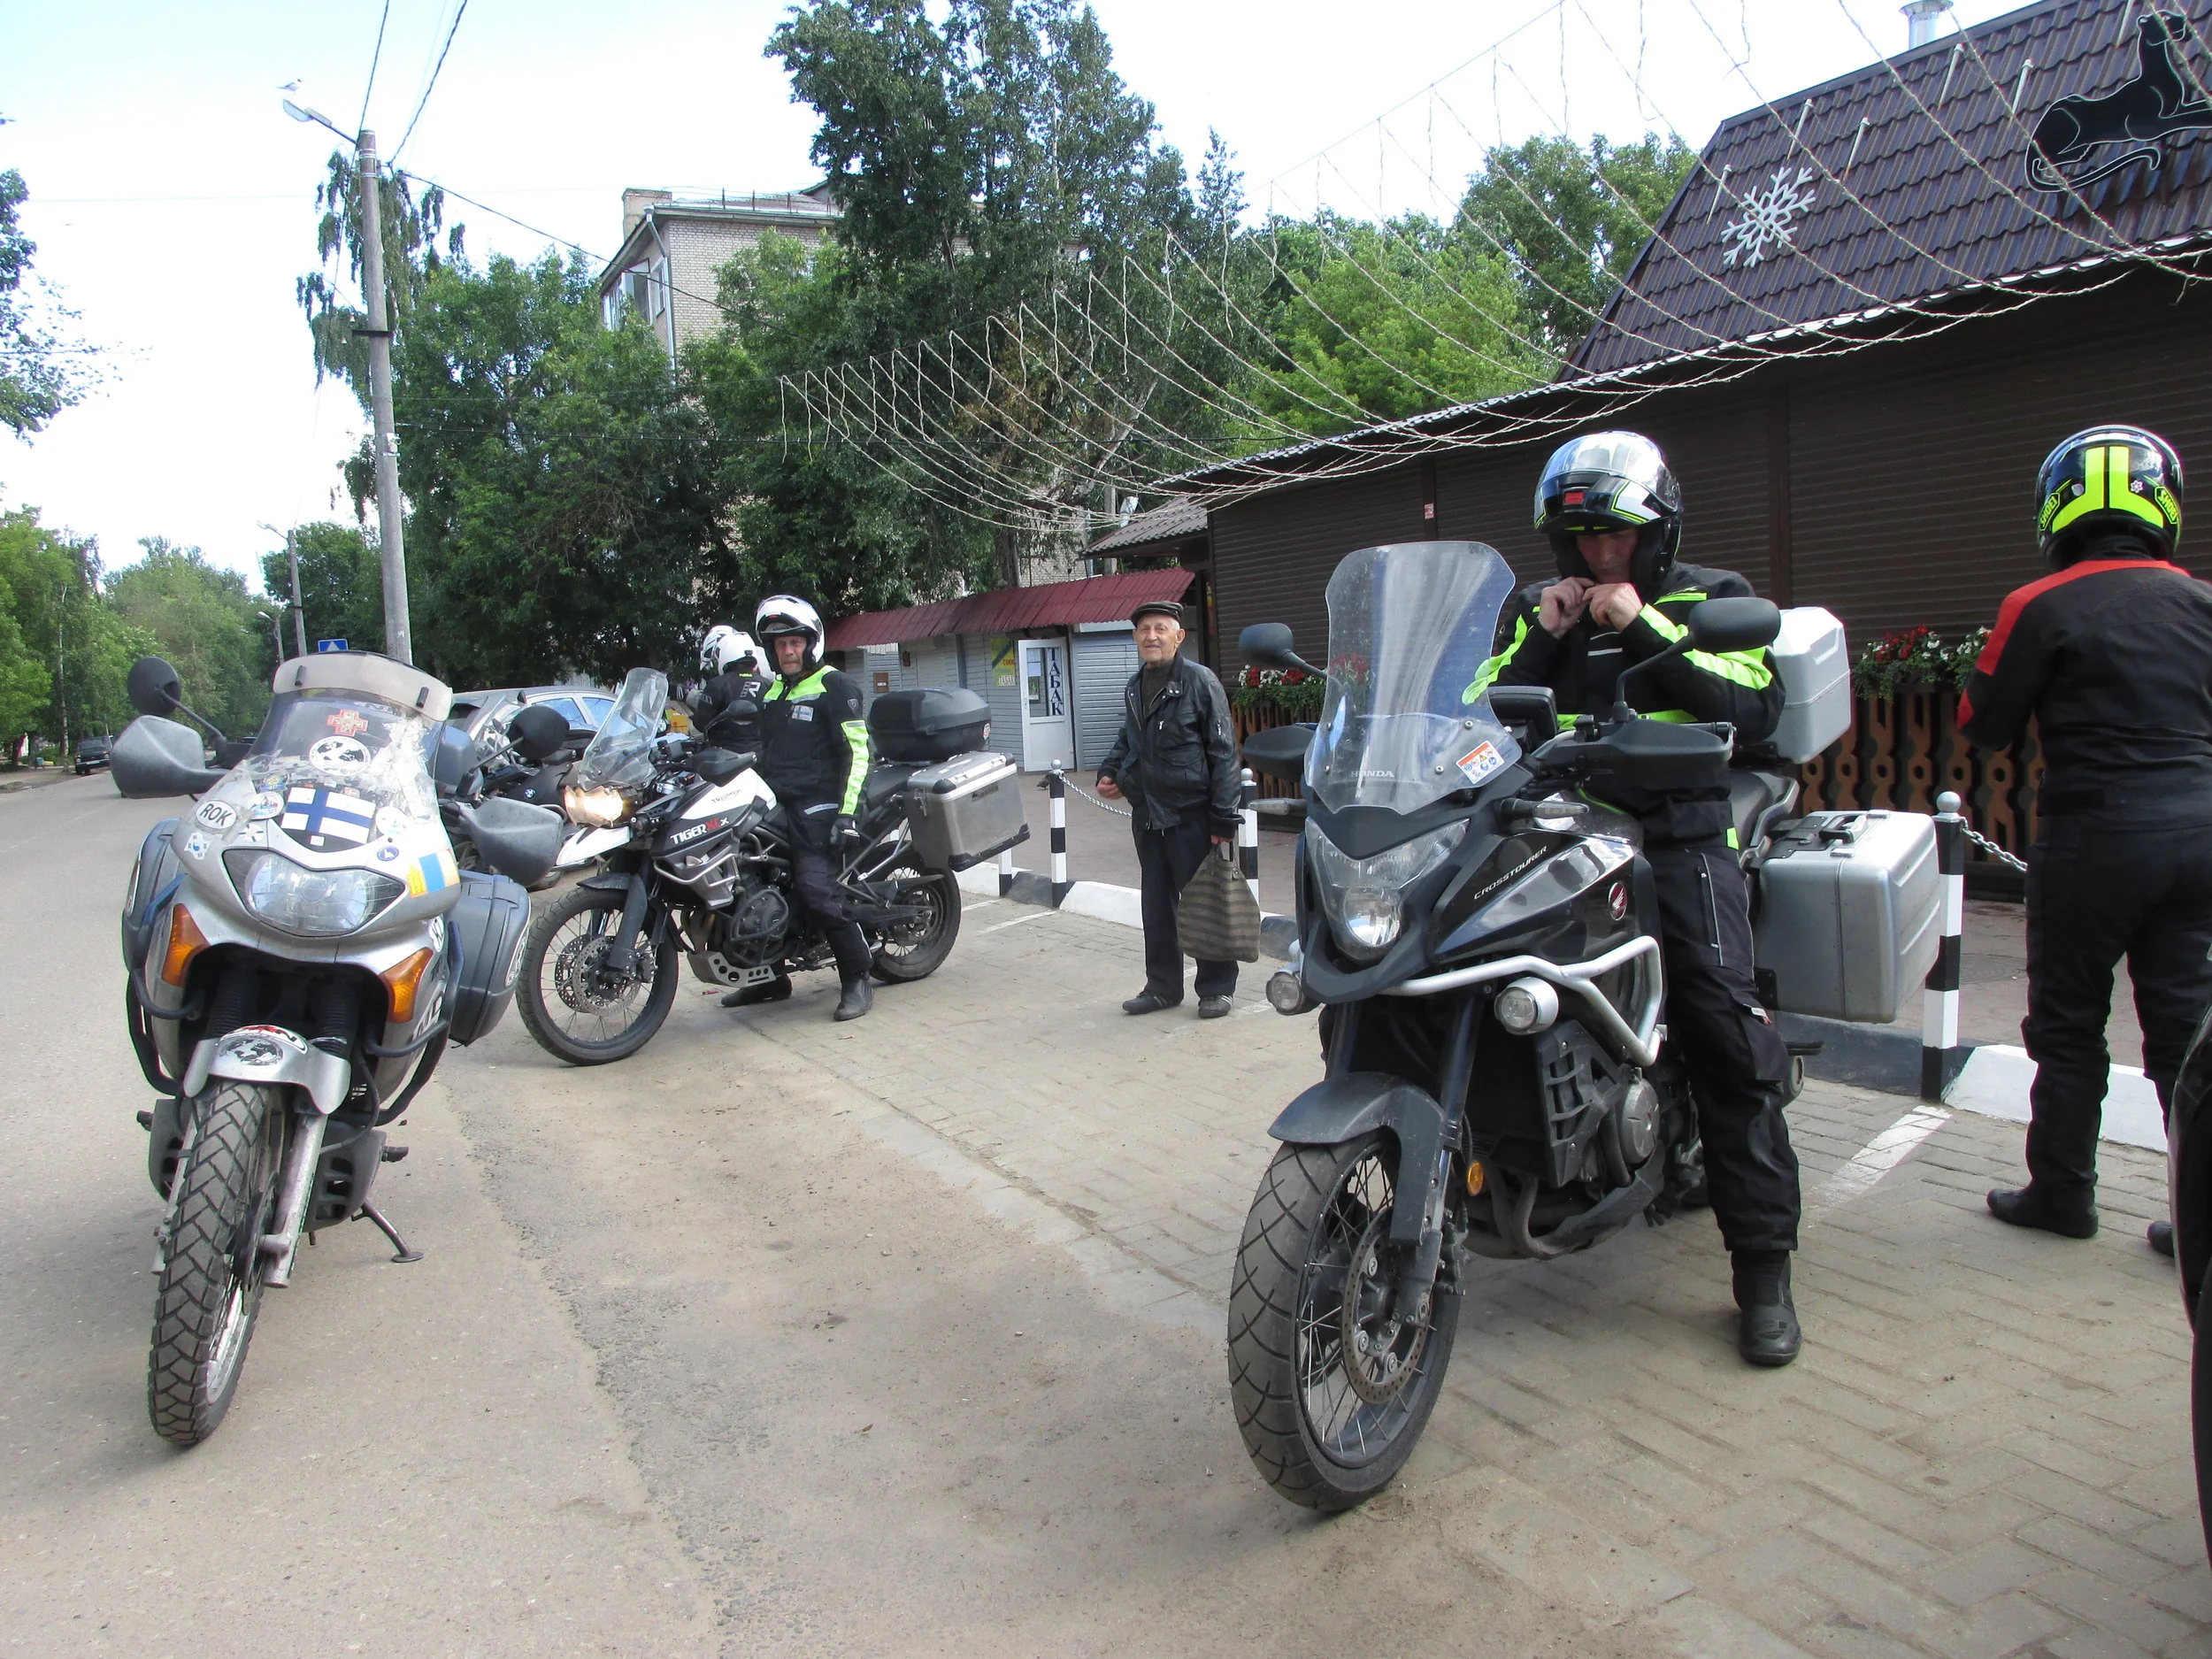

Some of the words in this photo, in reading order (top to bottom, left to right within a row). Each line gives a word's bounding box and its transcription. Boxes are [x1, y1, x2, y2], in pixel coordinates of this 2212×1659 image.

[2039, 495, 2058, 527] SHOEI
[1047, 647, 1065, 716] ТАБАК
[199, 803, 234, 826] ROK
[670, 823, 708, 845] TIGER
[1473, 845, 1548, 900] CROSSTOURER
